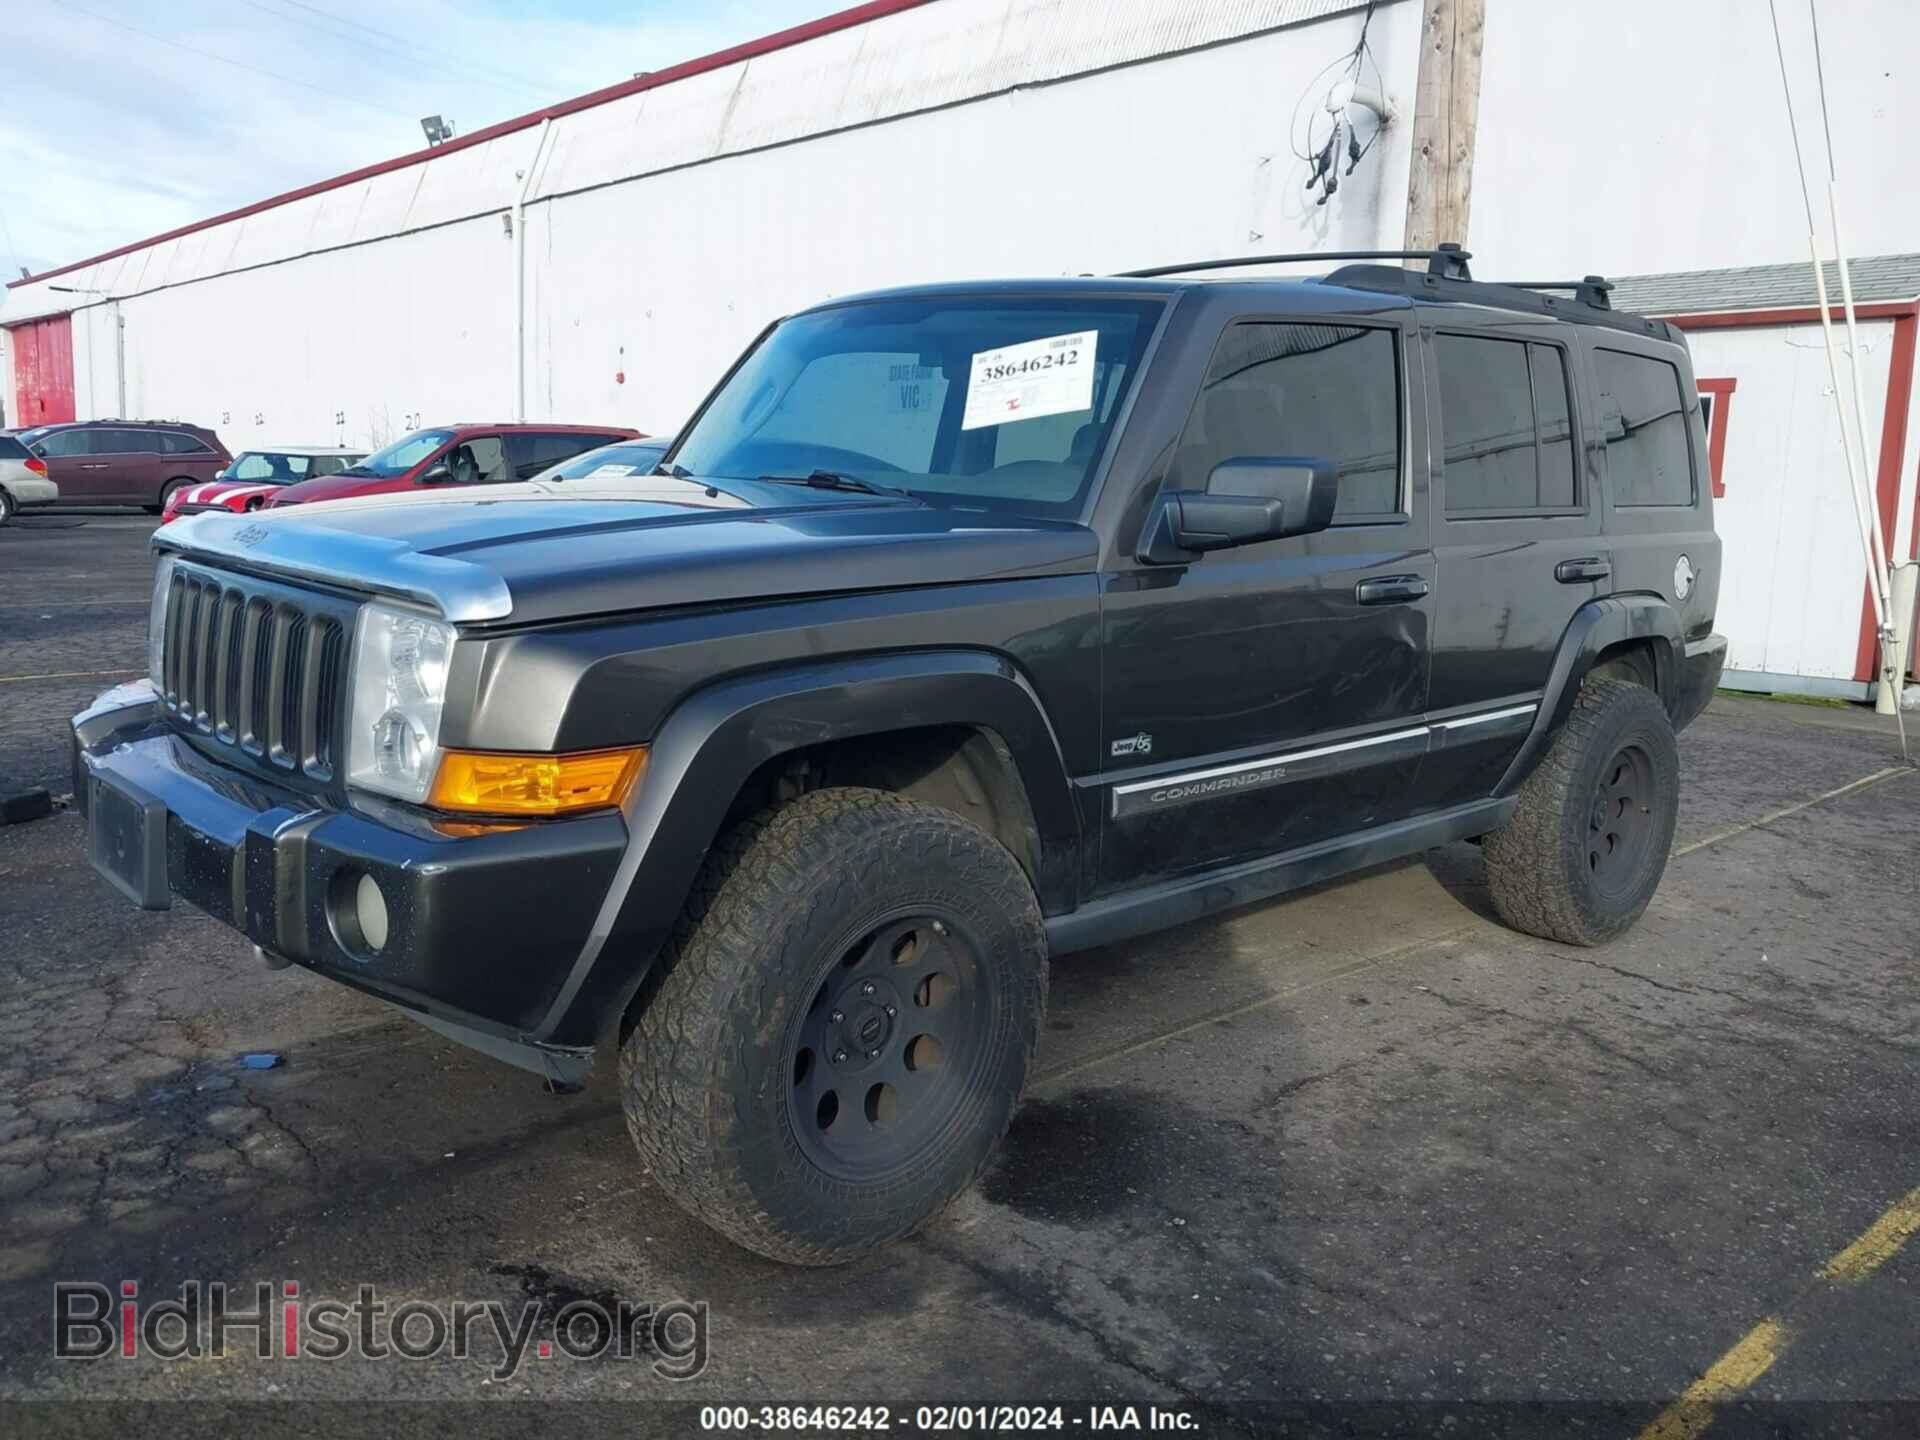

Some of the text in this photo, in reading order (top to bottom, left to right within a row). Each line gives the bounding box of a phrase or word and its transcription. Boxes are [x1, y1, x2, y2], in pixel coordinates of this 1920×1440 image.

[981, 351, 1078, 383] 38646242
[405, 412, 421, 431] 20
[1113, 741, 1134, 752] Jeep
[1152, 768, 1287, 802] COMMANDER
